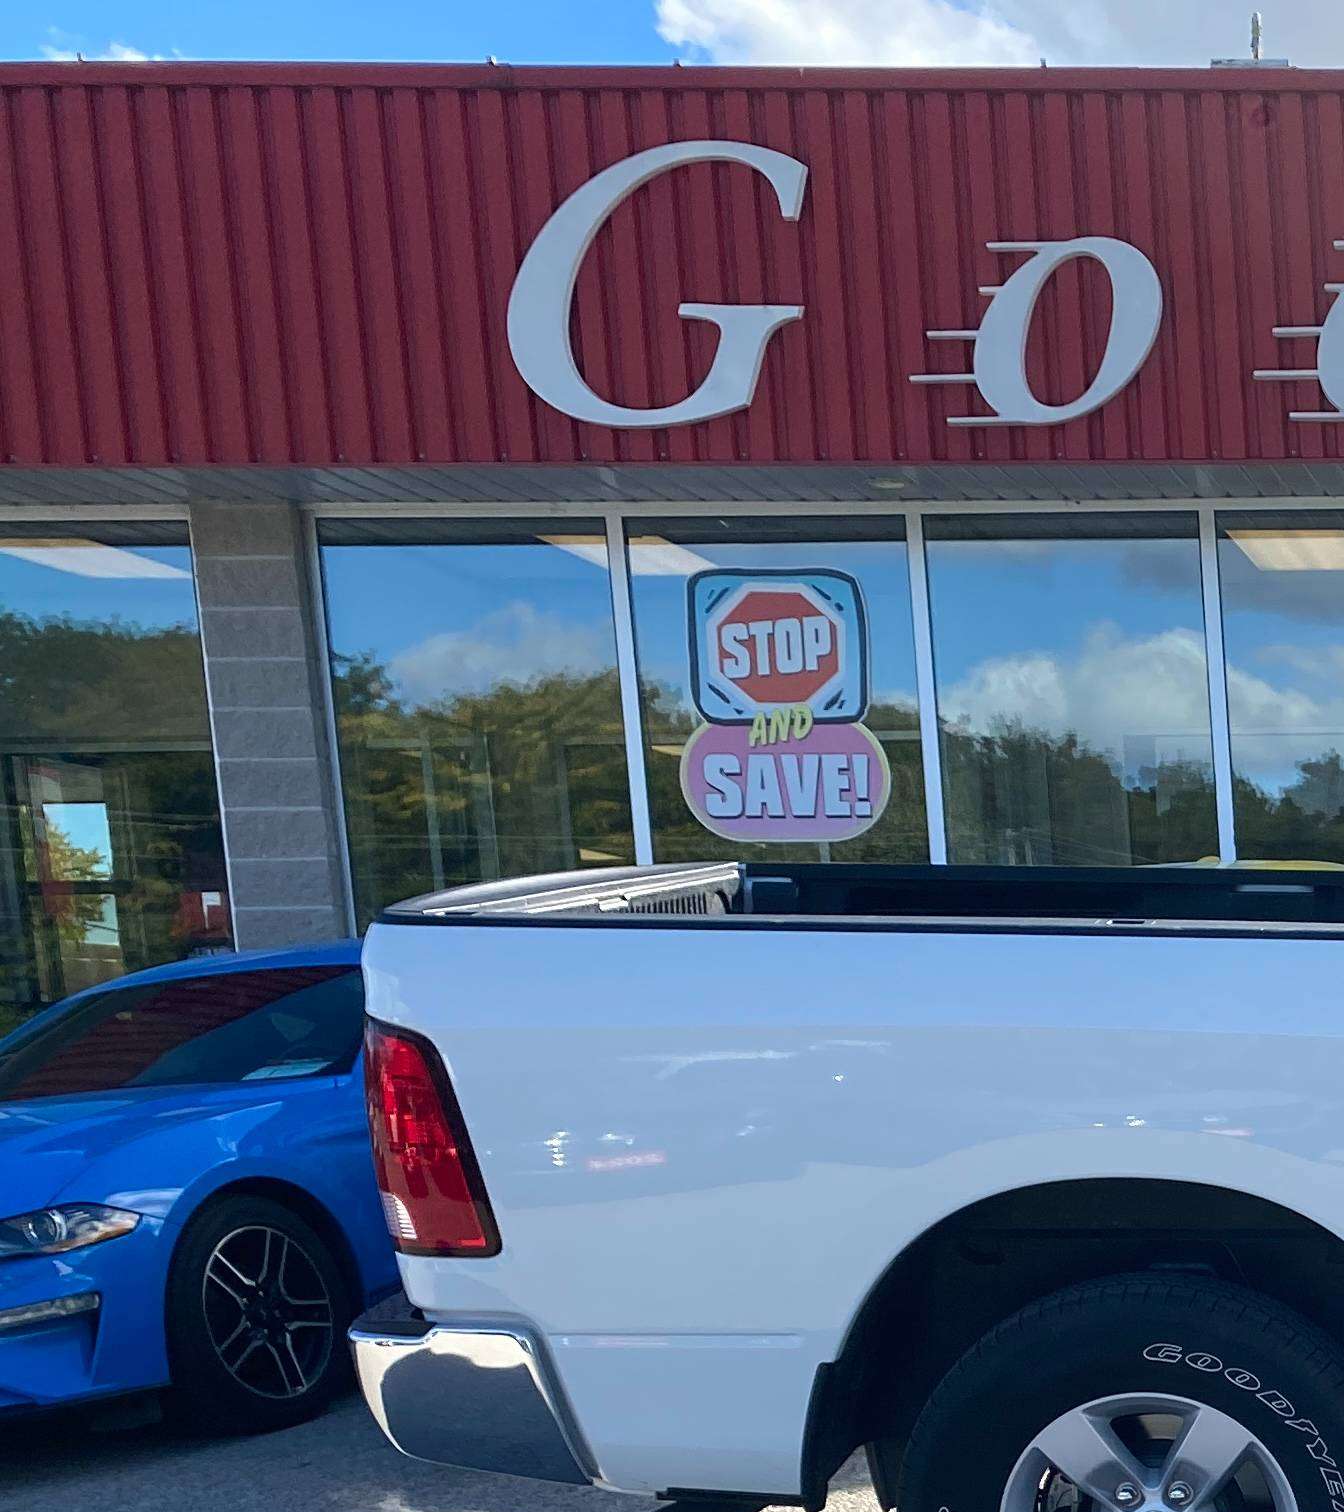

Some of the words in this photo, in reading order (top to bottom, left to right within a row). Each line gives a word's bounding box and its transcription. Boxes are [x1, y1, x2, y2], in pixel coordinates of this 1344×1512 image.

[720, 615, 832, 680] STOP
[749, 703, 814, 748] AND
[703, 752, 873, 819] SAVE!
